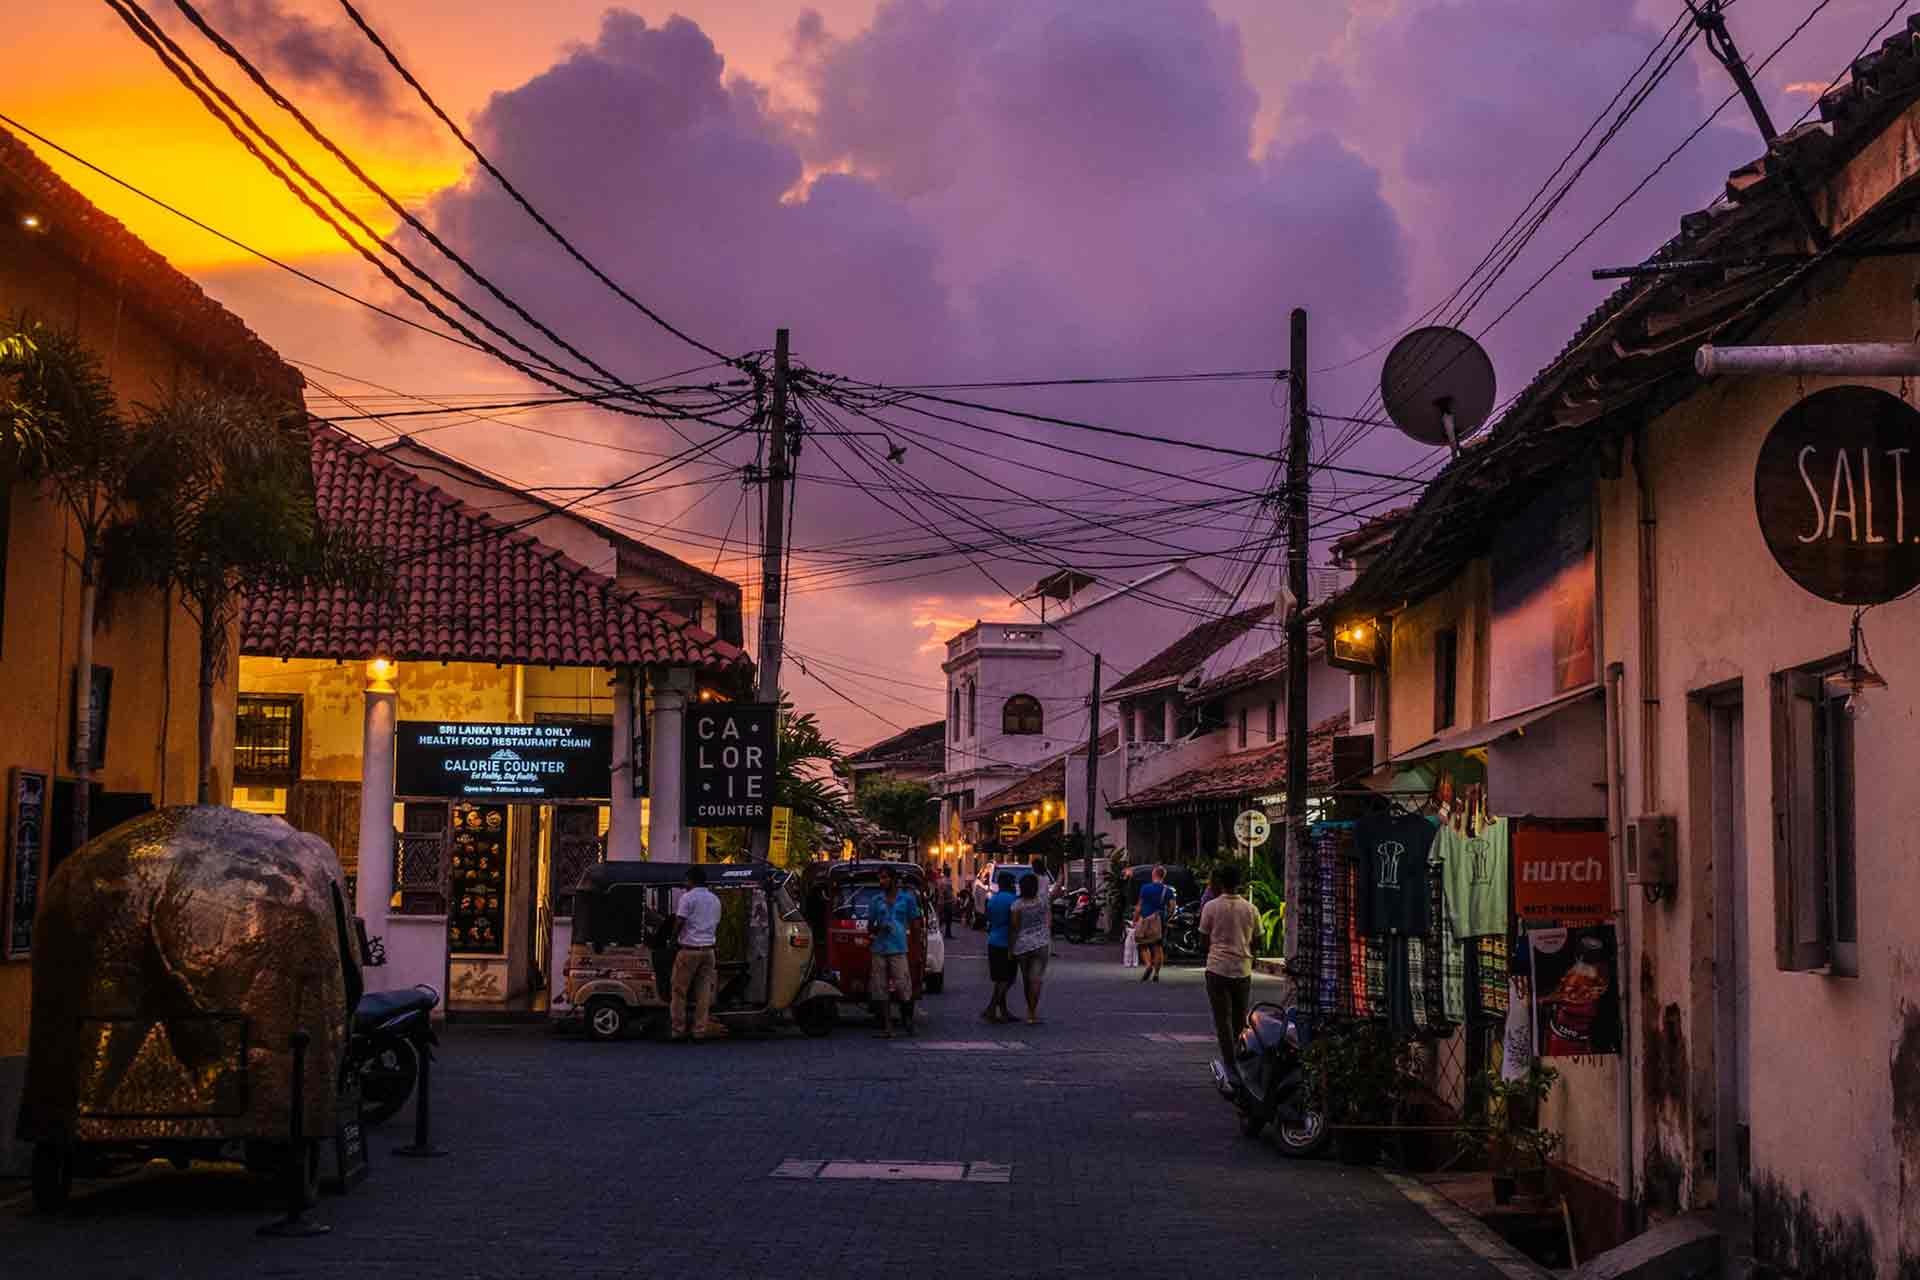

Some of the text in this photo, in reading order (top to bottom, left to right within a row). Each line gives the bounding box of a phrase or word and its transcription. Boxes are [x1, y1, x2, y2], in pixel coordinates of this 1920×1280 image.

[439, 726, 573, 737] SRI LANKA'S FIRST & ONLY
[419, 736, 591, 748] HEALTH FOOD RESTAURANT CHAIN
[444, 760, 565, 773] CALORIE COUNTER
[698, 804, 764, 817] COUNTER
